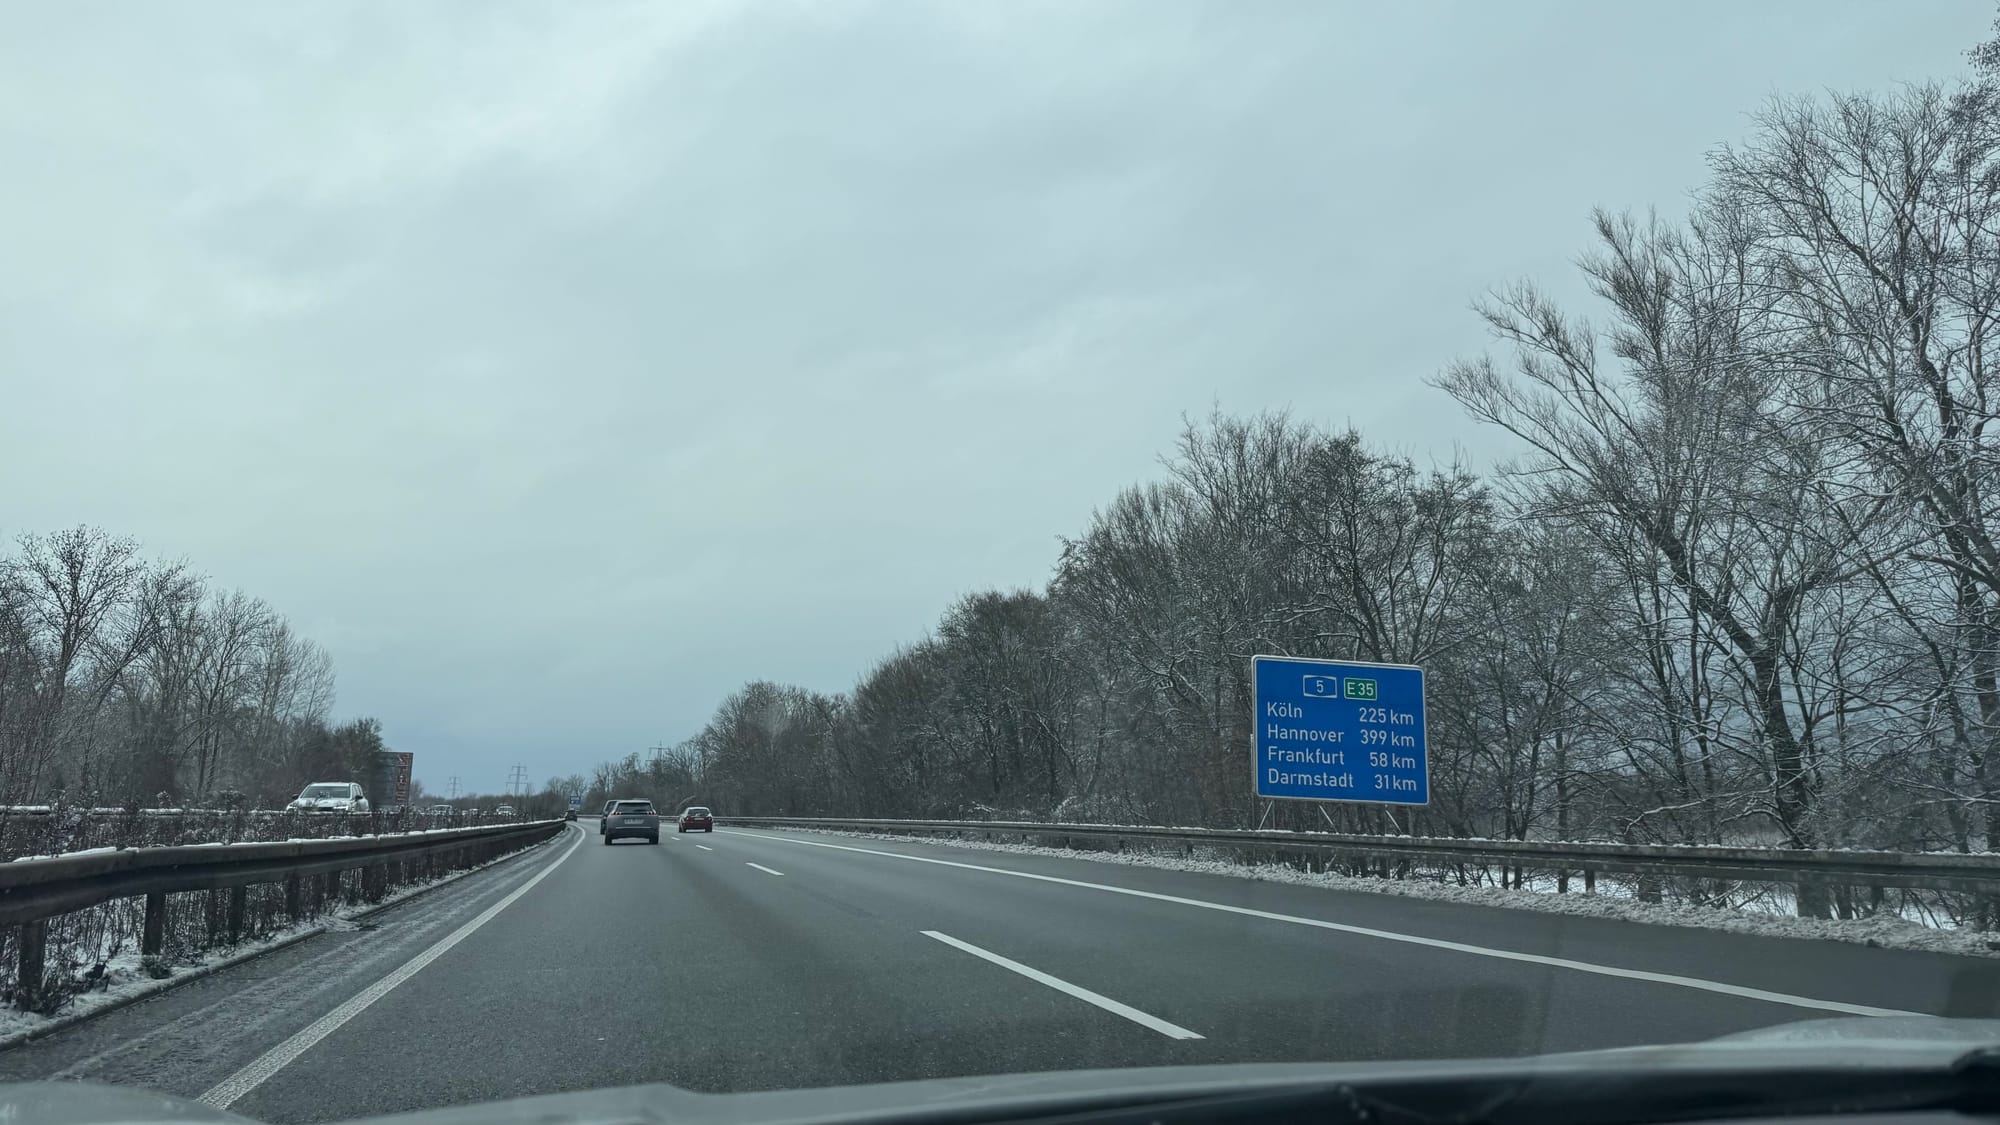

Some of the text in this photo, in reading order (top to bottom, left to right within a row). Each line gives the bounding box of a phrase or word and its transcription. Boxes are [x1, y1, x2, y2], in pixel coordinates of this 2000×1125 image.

[1316, 680, 1324, 693] 5
[1267, 702, 1414, 725] Köln 225 km
[1268, 724, 1414, 747] Hannover 399 km
[1268, 746, 1416, 768] Frankfurt 58 km
[1268, 769, 1417, 791] Darmstadt 31 km
